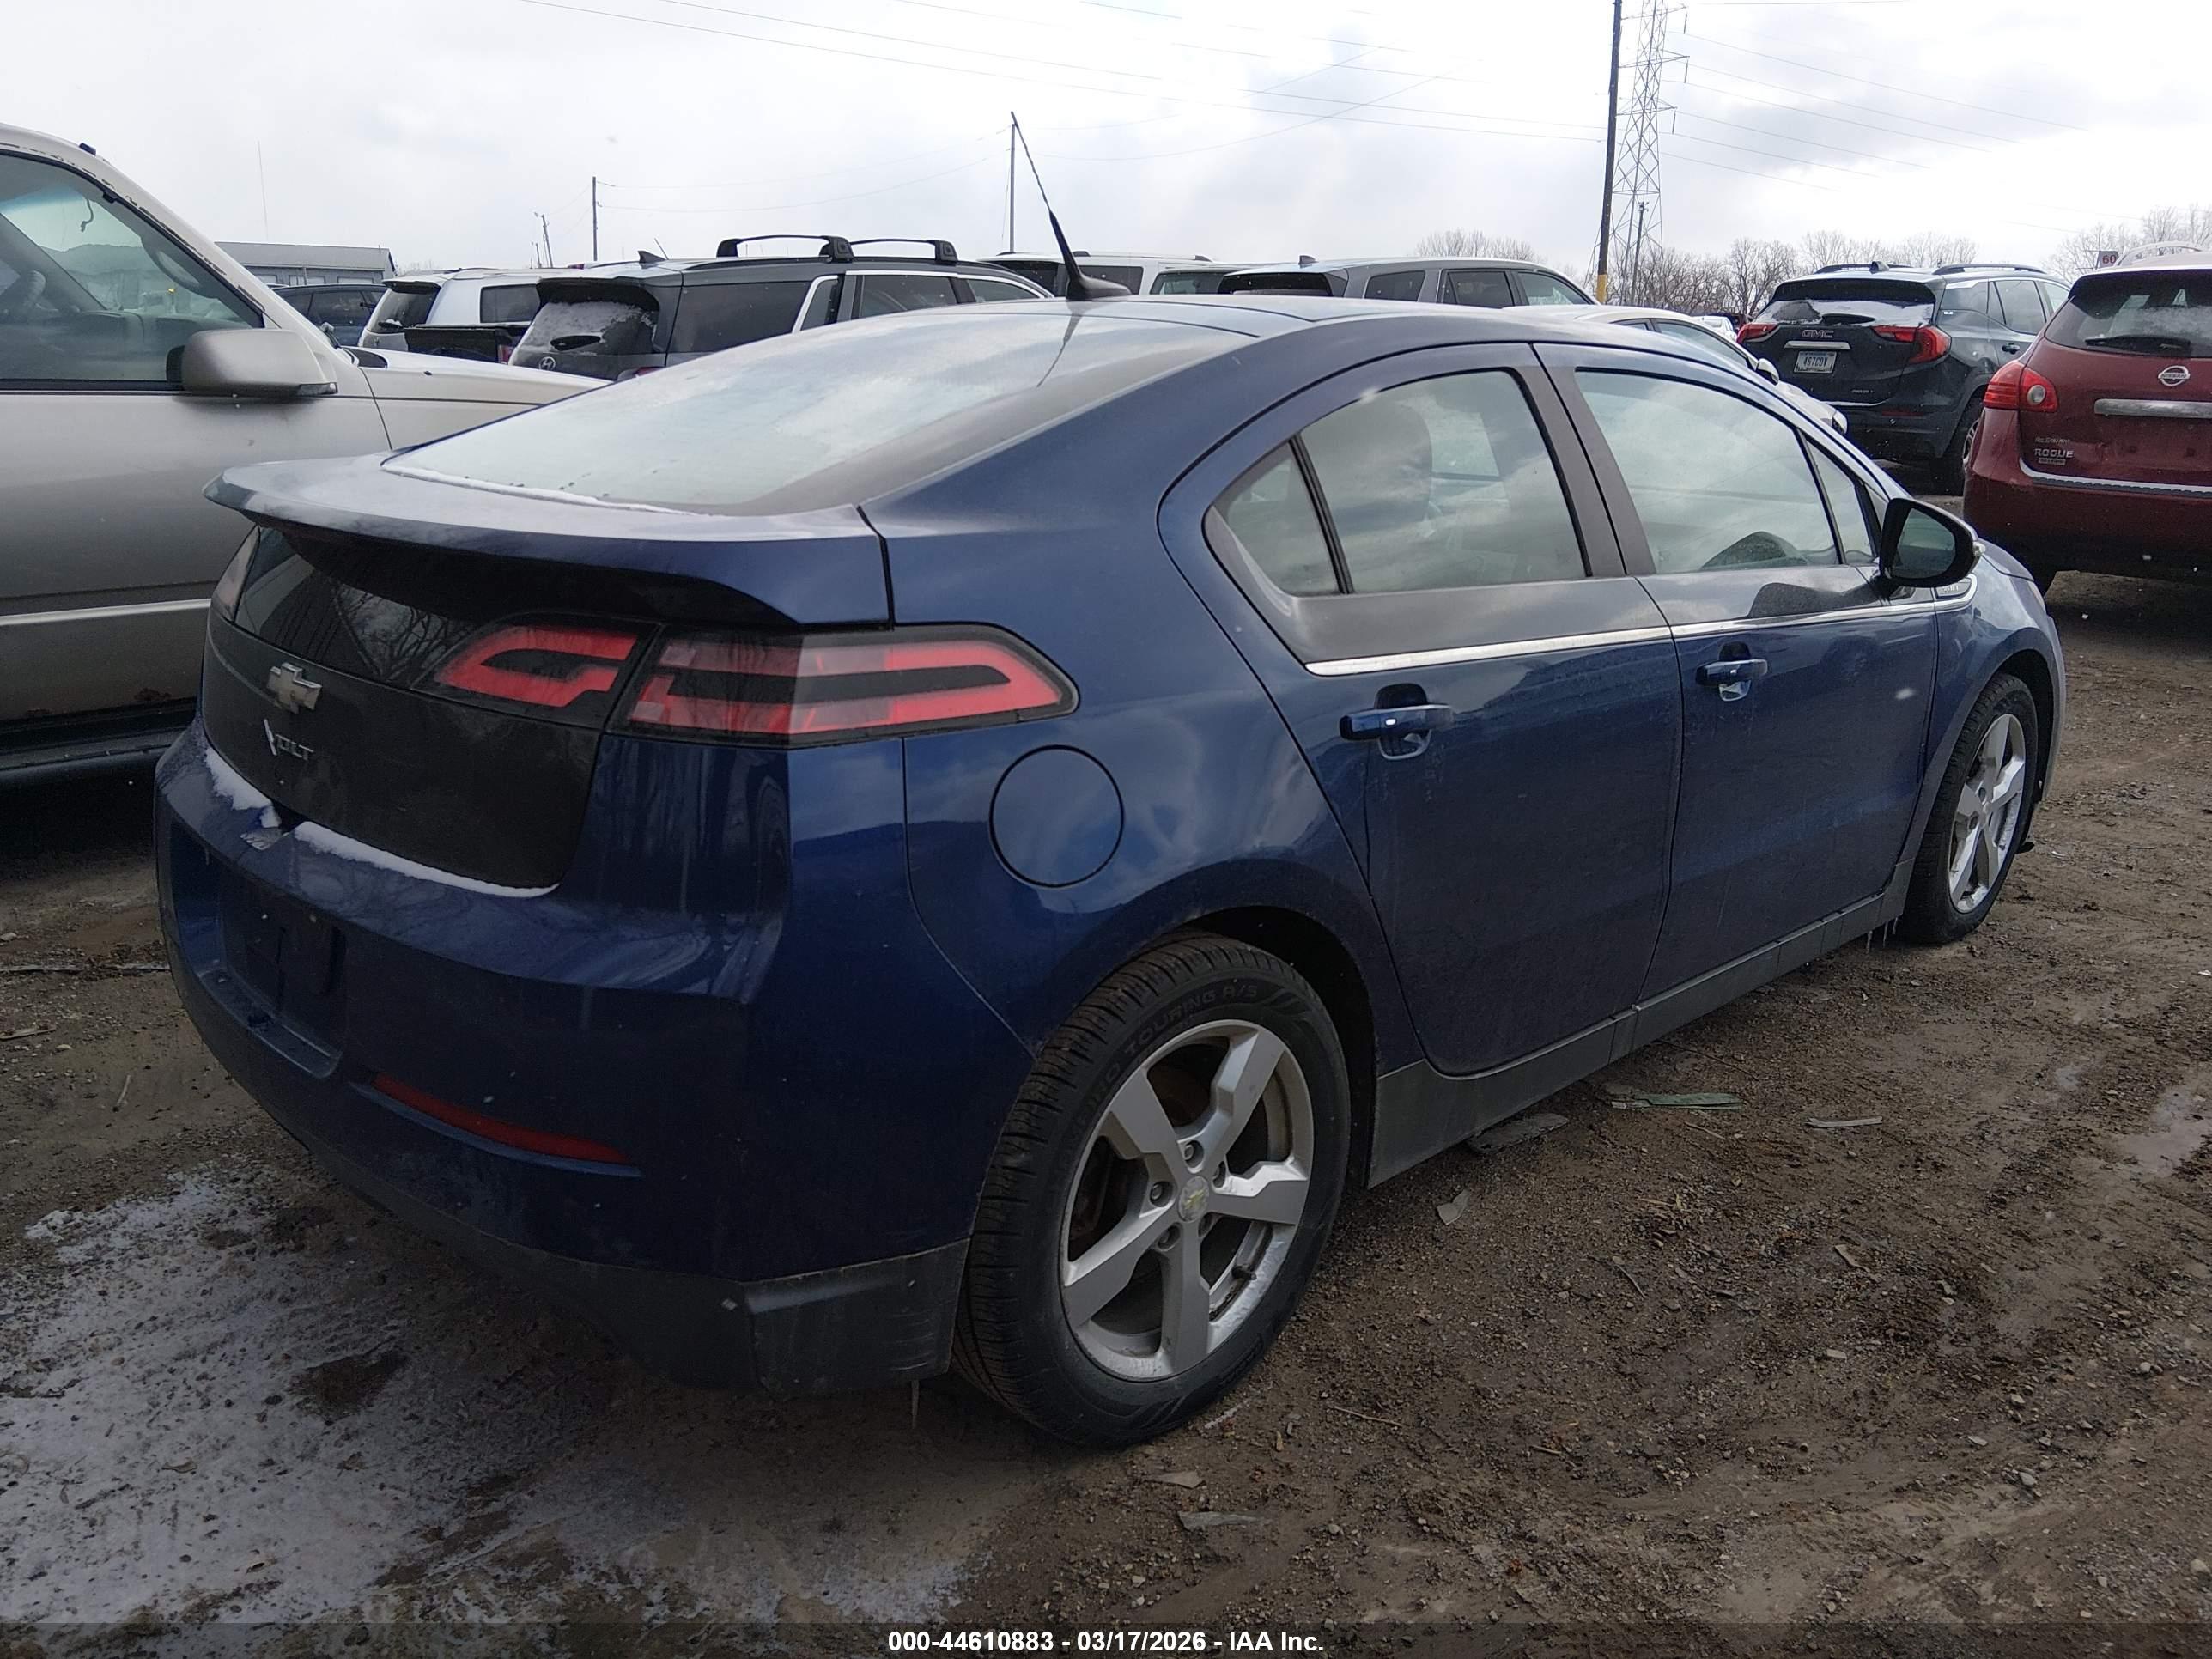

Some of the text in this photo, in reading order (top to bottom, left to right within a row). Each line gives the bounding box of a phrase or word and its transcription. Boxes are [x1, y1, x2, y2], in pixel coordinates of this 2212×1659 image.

[2102, 254, 2117, 264] 60
[1802, 329, 1835, 338] GMC
[2034, 448, 2075, 458] ROGUE
[264, 719, 314, 761] VOLT
[1123, 990, 1217, 1056] TOURING
